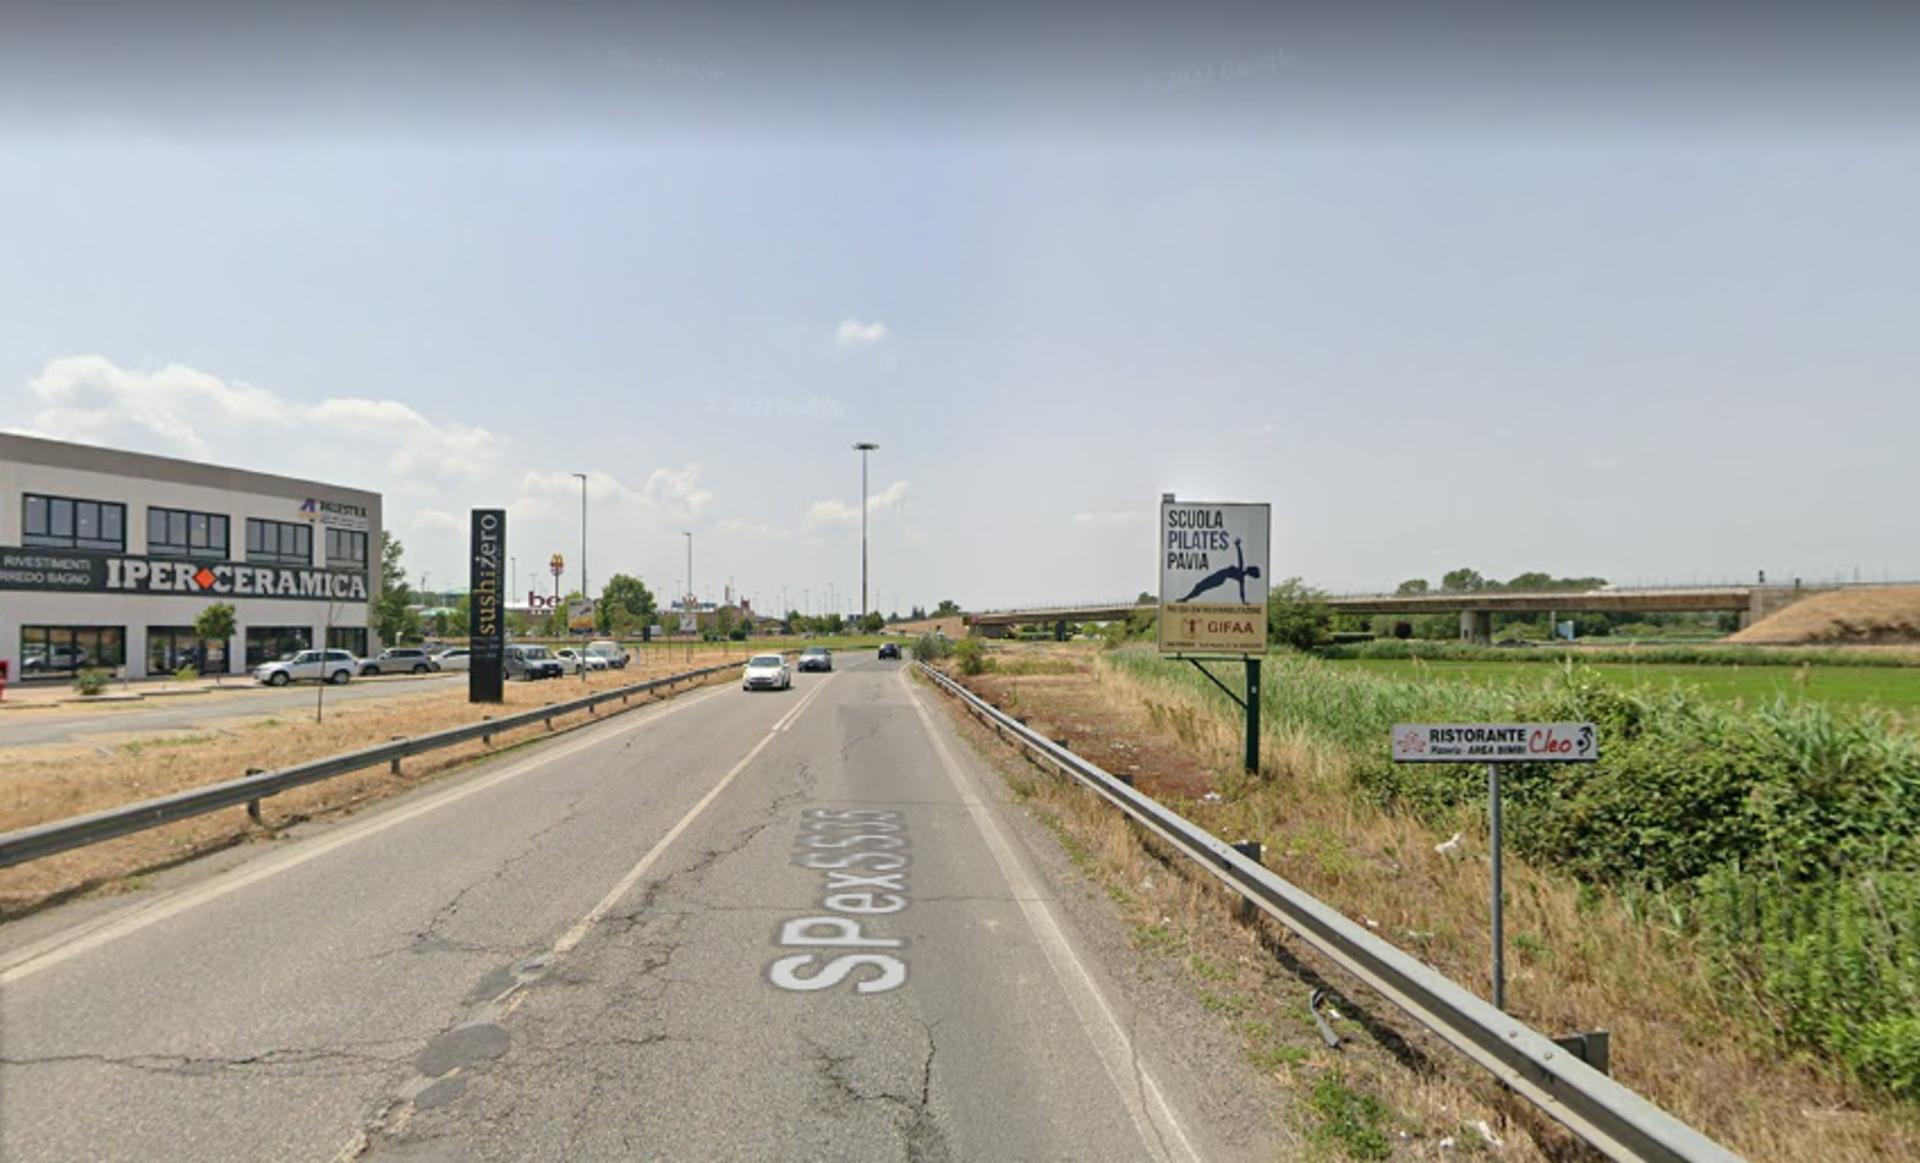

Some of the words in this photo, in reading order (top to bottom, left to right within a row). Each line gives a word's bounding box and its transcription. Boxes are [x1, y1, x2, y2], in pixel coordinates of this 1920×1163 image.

[1168, 509, 1223, 529] SCUOLA
[1168, 530, 1230, 551] PILATES
[3, 555, 92, 571] RIVESTIMENTI
[1167, 552, 1209, 571] PAVIA
[47, 572, 91, 586] BAGNO
[106, 558, 199, 592] IPER
[204, 566, 367, 599] CERAMICA
[1207, 620, 1255, 635] GIFAA
[1429, 728, 1526, 743] RISTORANTE
[1529, 728, 1573, 754] Cleo
[1467, 744, 1494, 755] AREA
